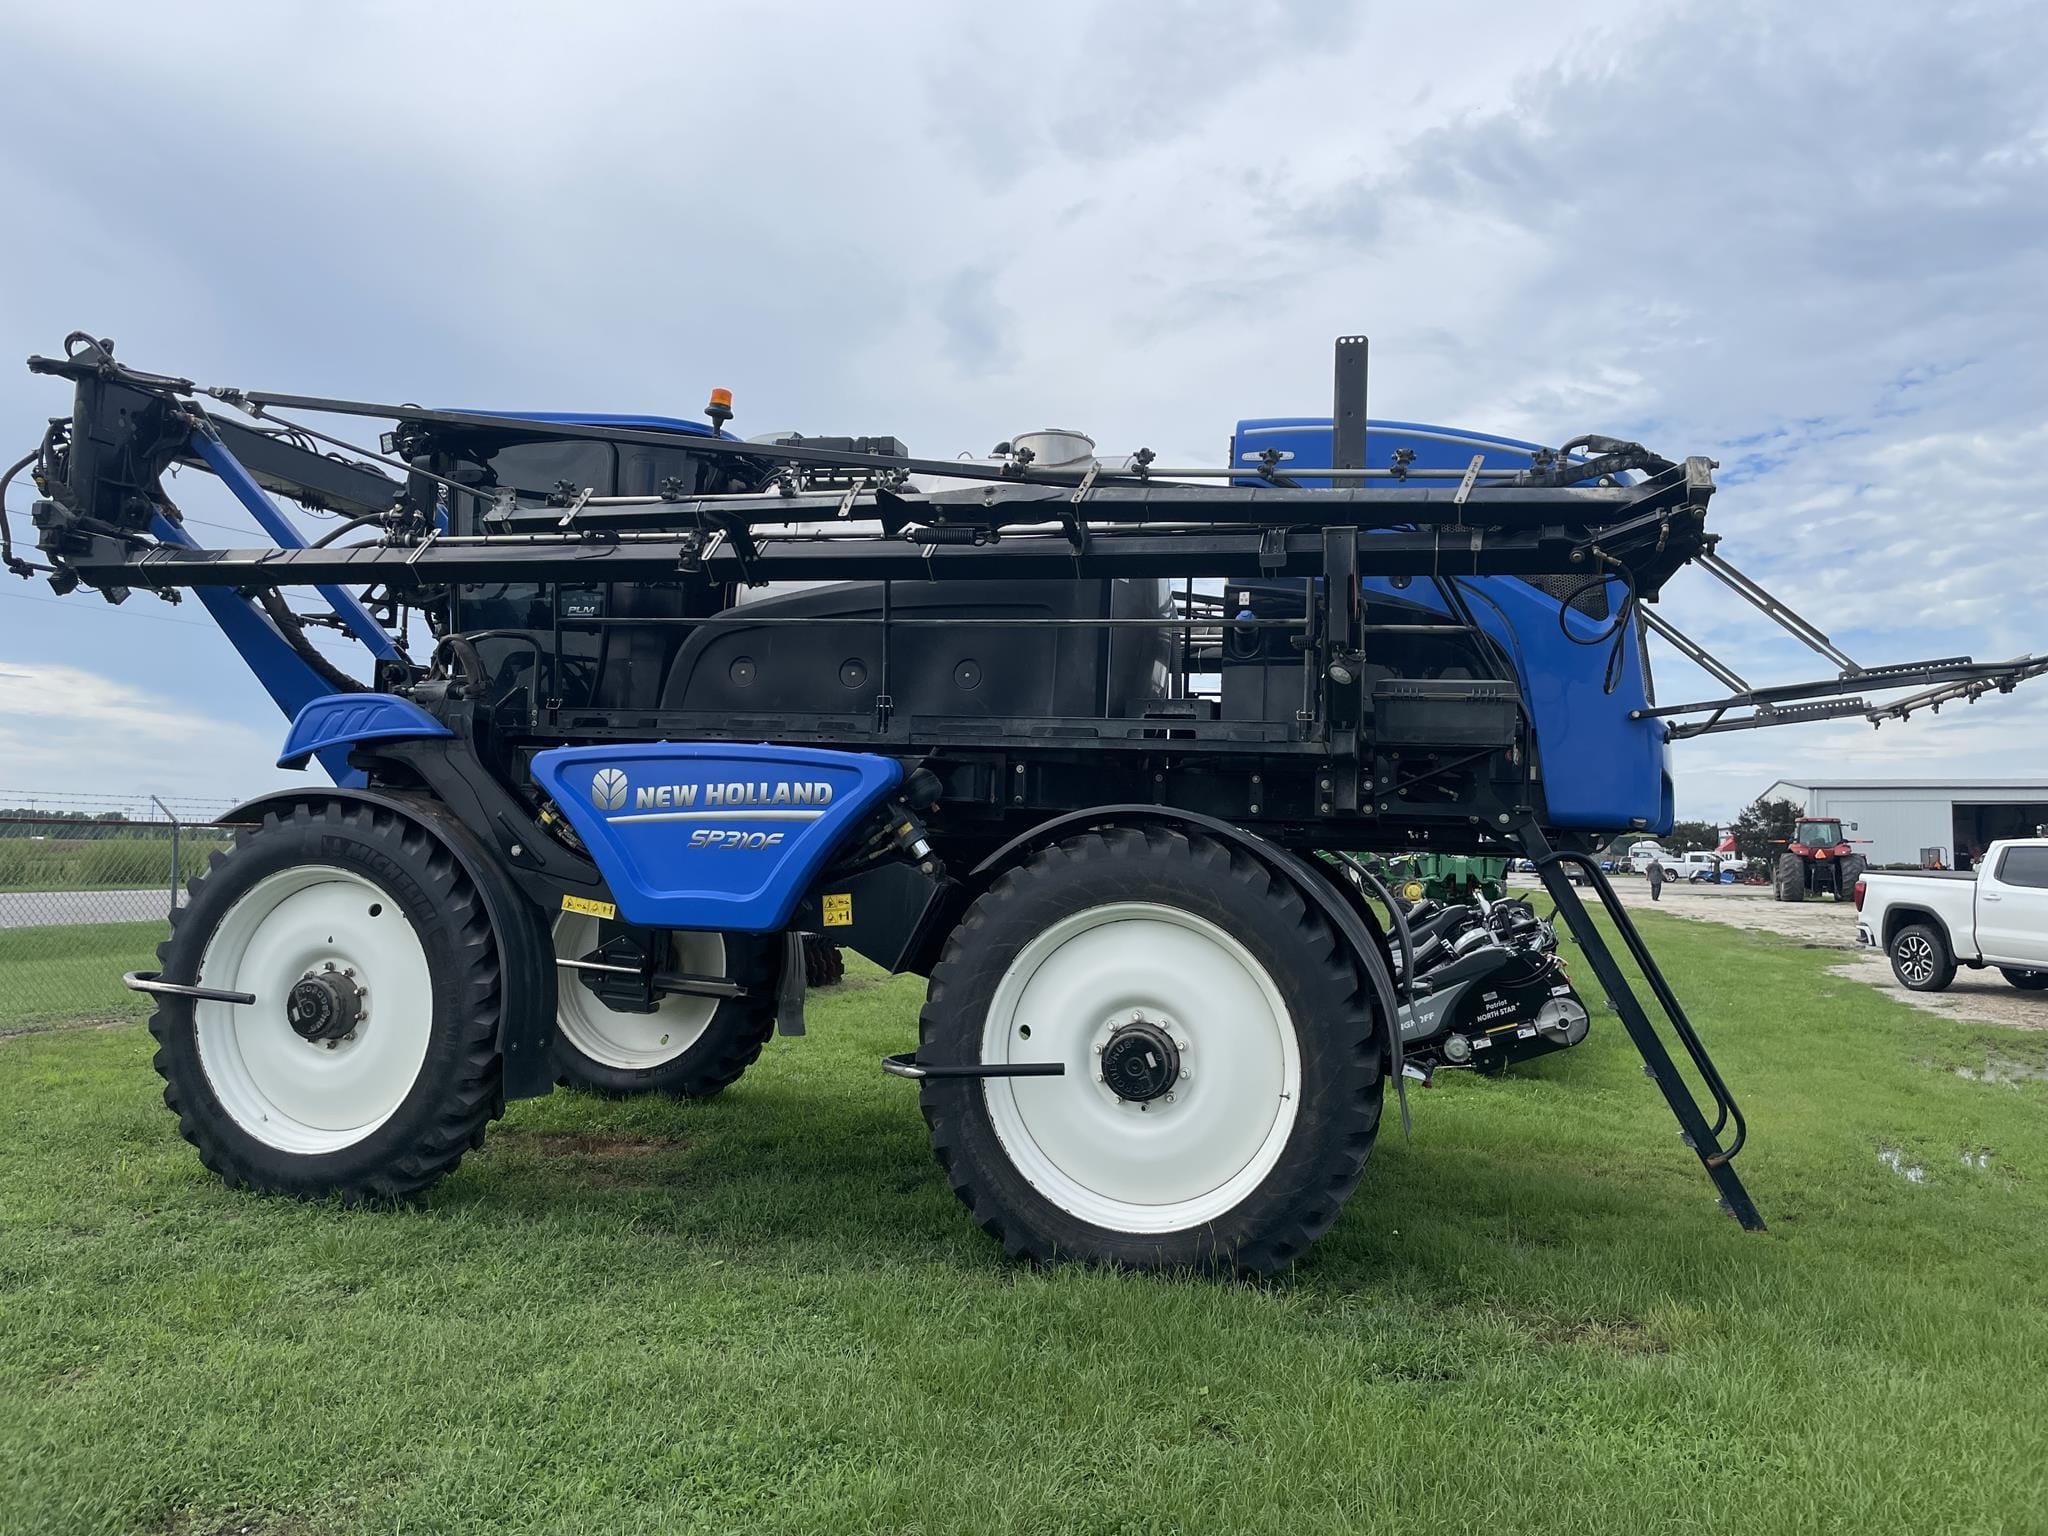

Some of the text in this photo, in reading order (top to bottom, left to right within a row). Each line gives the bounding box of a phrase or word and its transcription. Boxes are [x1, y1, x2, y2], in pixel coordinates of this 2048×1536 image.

[636, 782, 833, 809] NEW HOLLAND
[687, 829, 785, 850] SP310F
[1476, 1004, 1517, 1022] NORTH STAR
[1485, 999, 1508, 1011] Patriot
